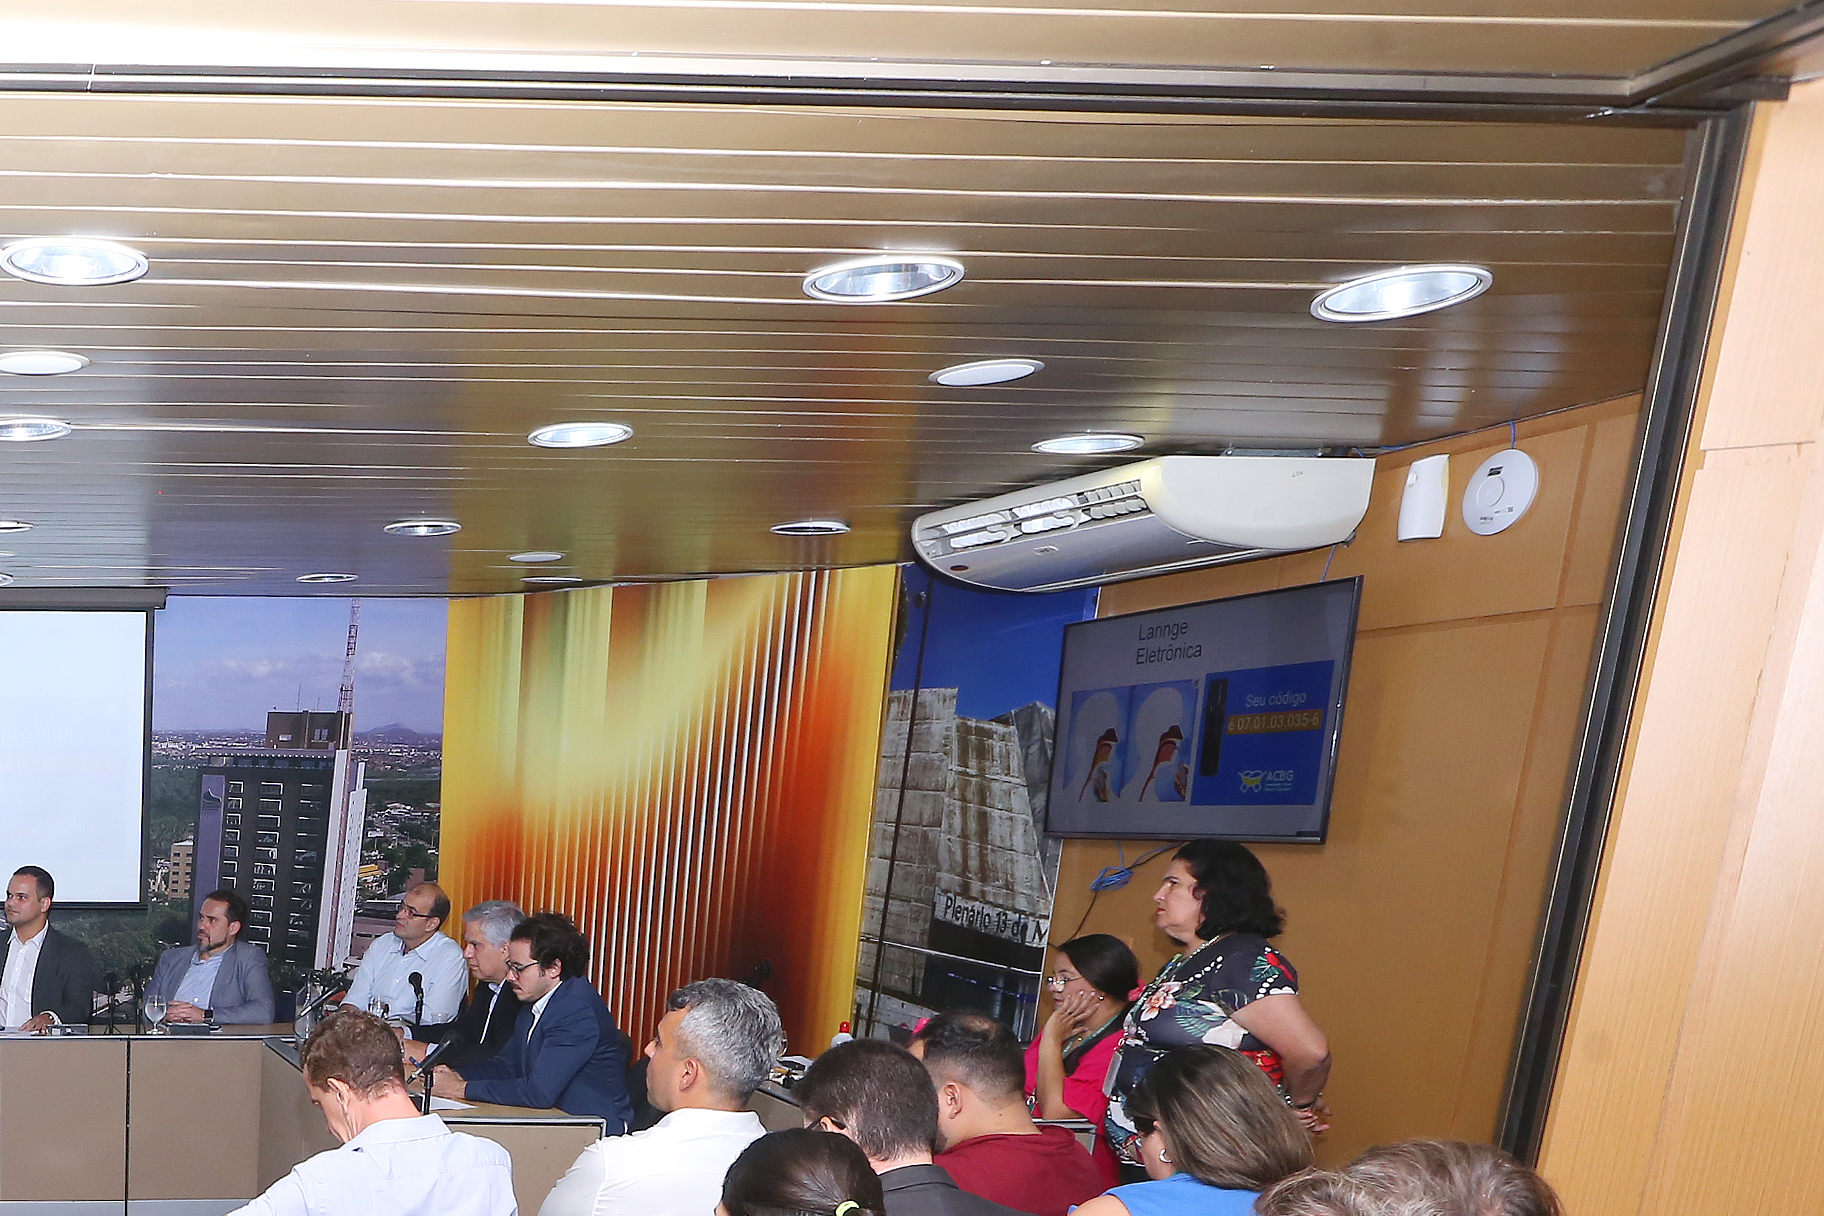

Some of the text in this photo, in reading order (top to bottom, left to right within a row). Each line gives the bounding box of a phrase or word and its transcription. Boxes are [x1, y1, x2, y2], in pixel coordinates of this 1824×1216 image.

[1138, 621, 1188, 641] Laringe
[1136, 642, 1202, 664] Eletrônica
[1245, 690, 1307, 708] Seu código
[944, 895, 990, 930] Plenário
[996, 911, 1008, 933] 13
